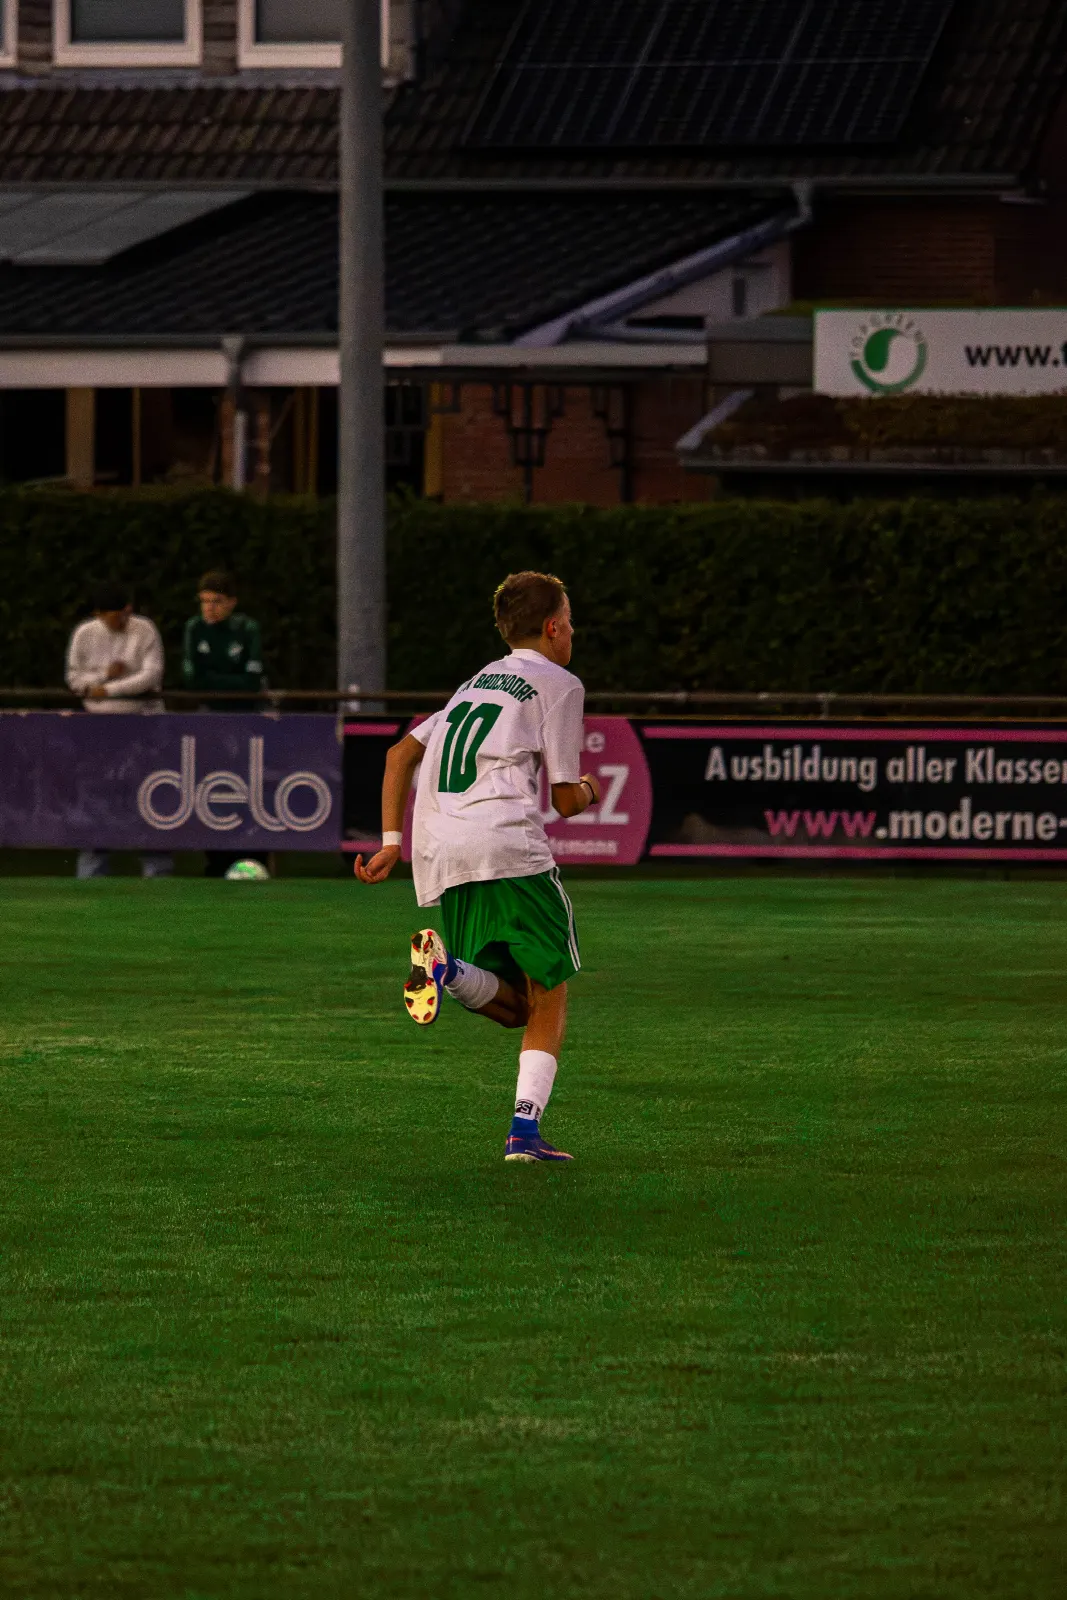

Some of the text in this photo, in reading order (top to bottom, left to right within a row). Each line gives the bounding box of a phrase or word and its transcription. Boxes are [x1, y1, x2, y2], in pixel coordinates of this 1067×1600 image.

[137, 736, 332, 831] delo
[438, 701, 503, 793] 10
[704, 745, 878, 792] Ausbildung
[886, 746, 957, 784] aller
